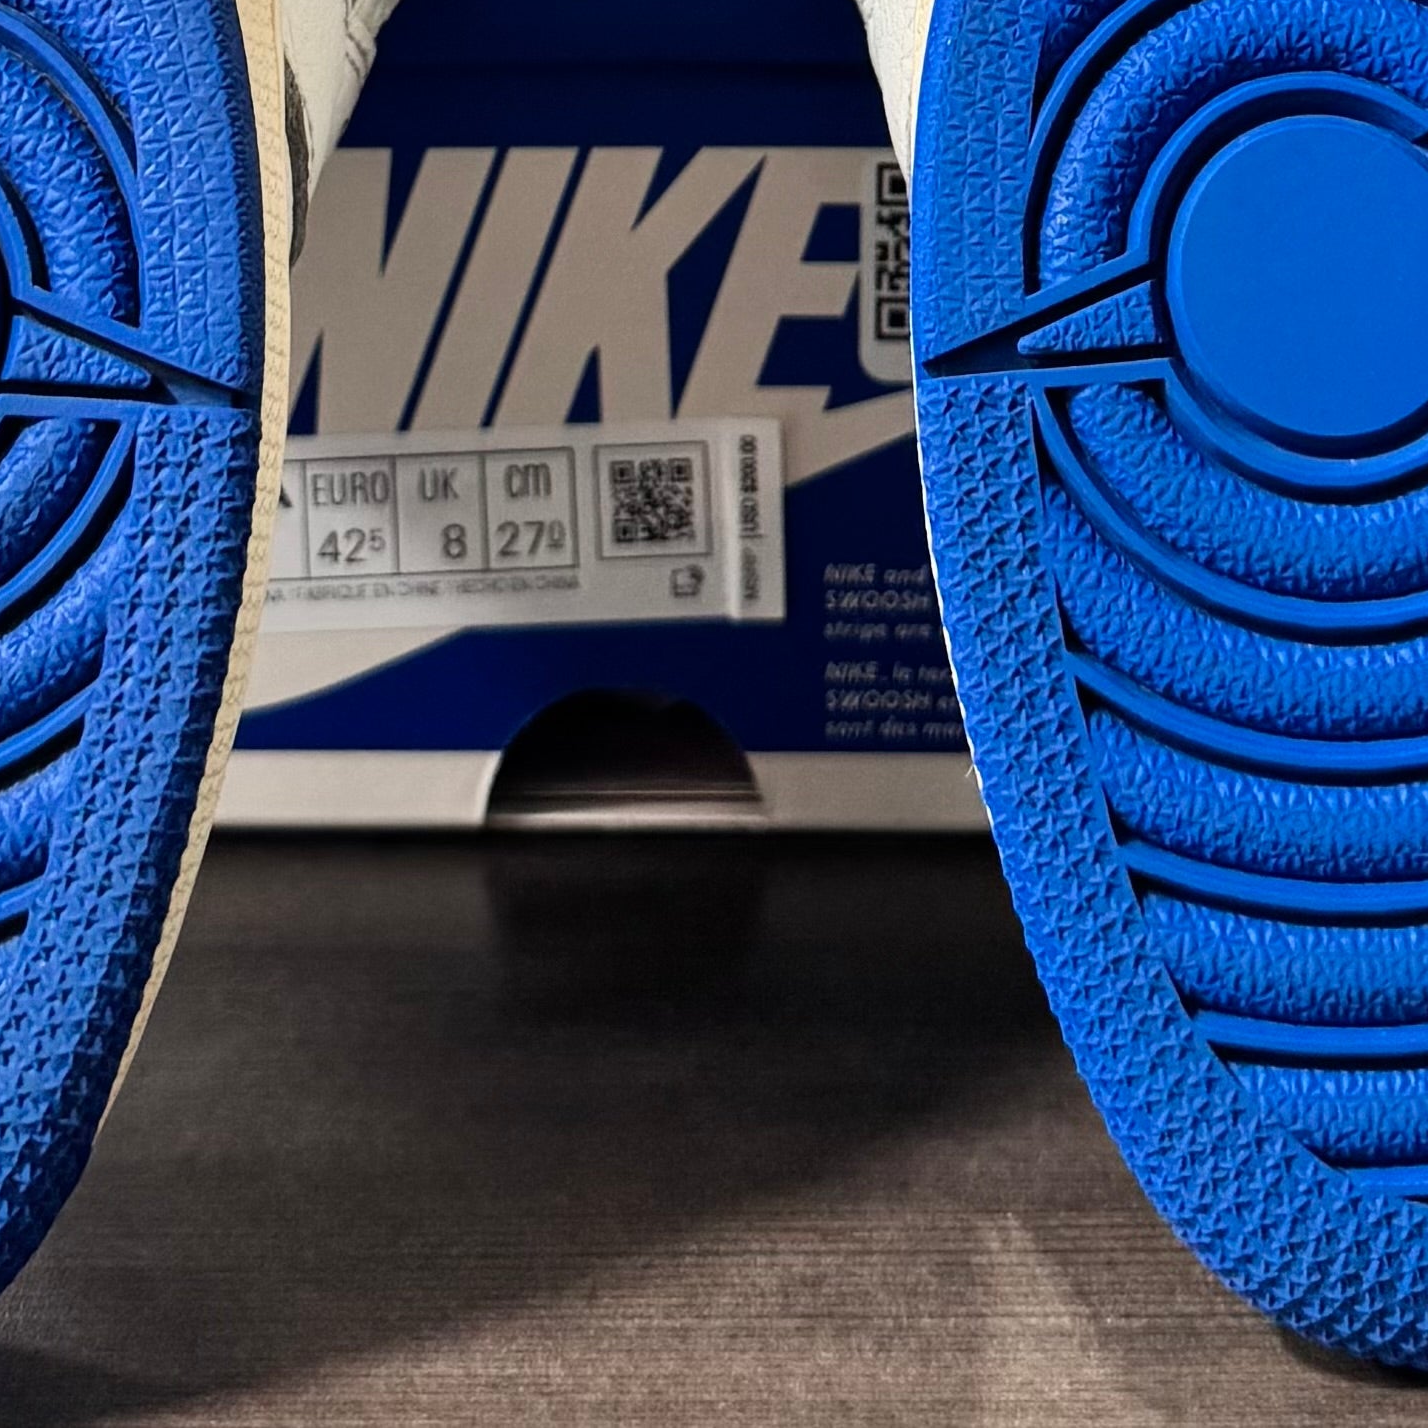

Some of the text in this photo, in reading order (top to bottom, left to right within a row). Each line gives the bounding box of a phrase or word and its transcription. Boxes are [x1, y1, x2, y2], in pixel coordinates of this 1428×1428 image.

[285, 146, 864, 436] NIKE
[311, 470, 390, 506] EURO
[419, 467, 459, 501] UK
[440, 523, 467, 560] 8
